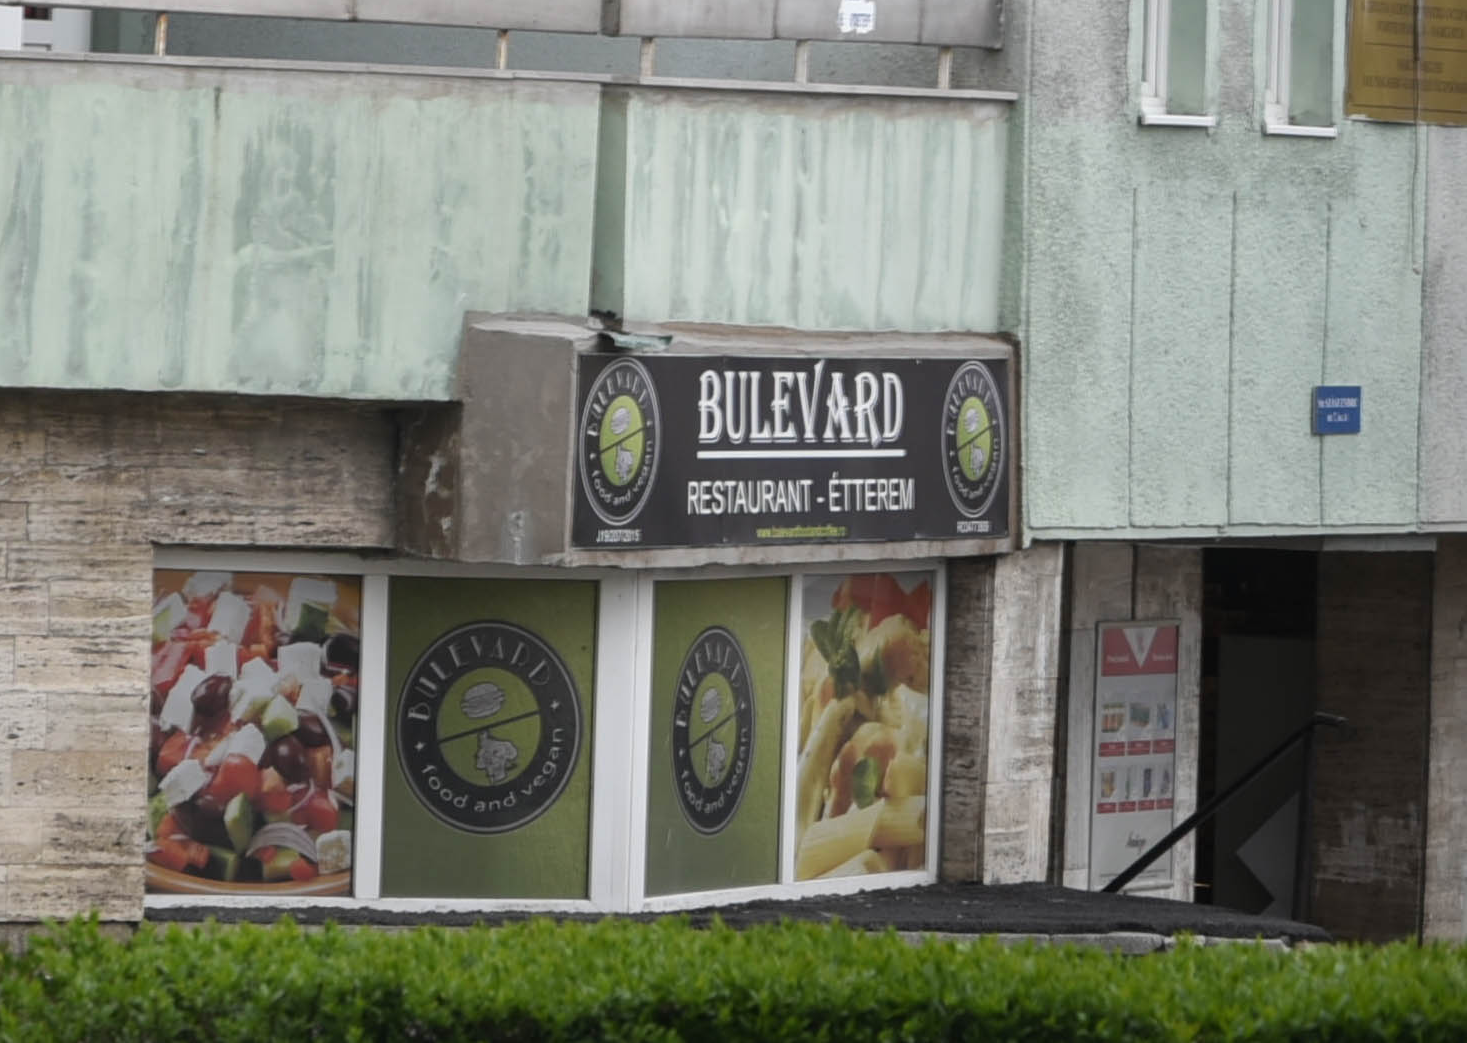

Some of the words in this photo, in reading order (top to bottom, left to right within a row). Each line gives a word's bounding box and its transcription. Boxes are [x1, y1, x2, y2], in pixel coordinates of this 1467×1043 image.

[697, 359, 905, 447] BULEVARD
[687, 478, 813, 515] RESTAURANT
[828, 472, 916, 513] ÉTTEREM
[408, 634, 550, 721] BULEVARD
[421, 764, 469, 809] food
[474, 790, 517, 814] and
[521, 727, 565, 796] vegan
[704, 796, 725, 815] and
